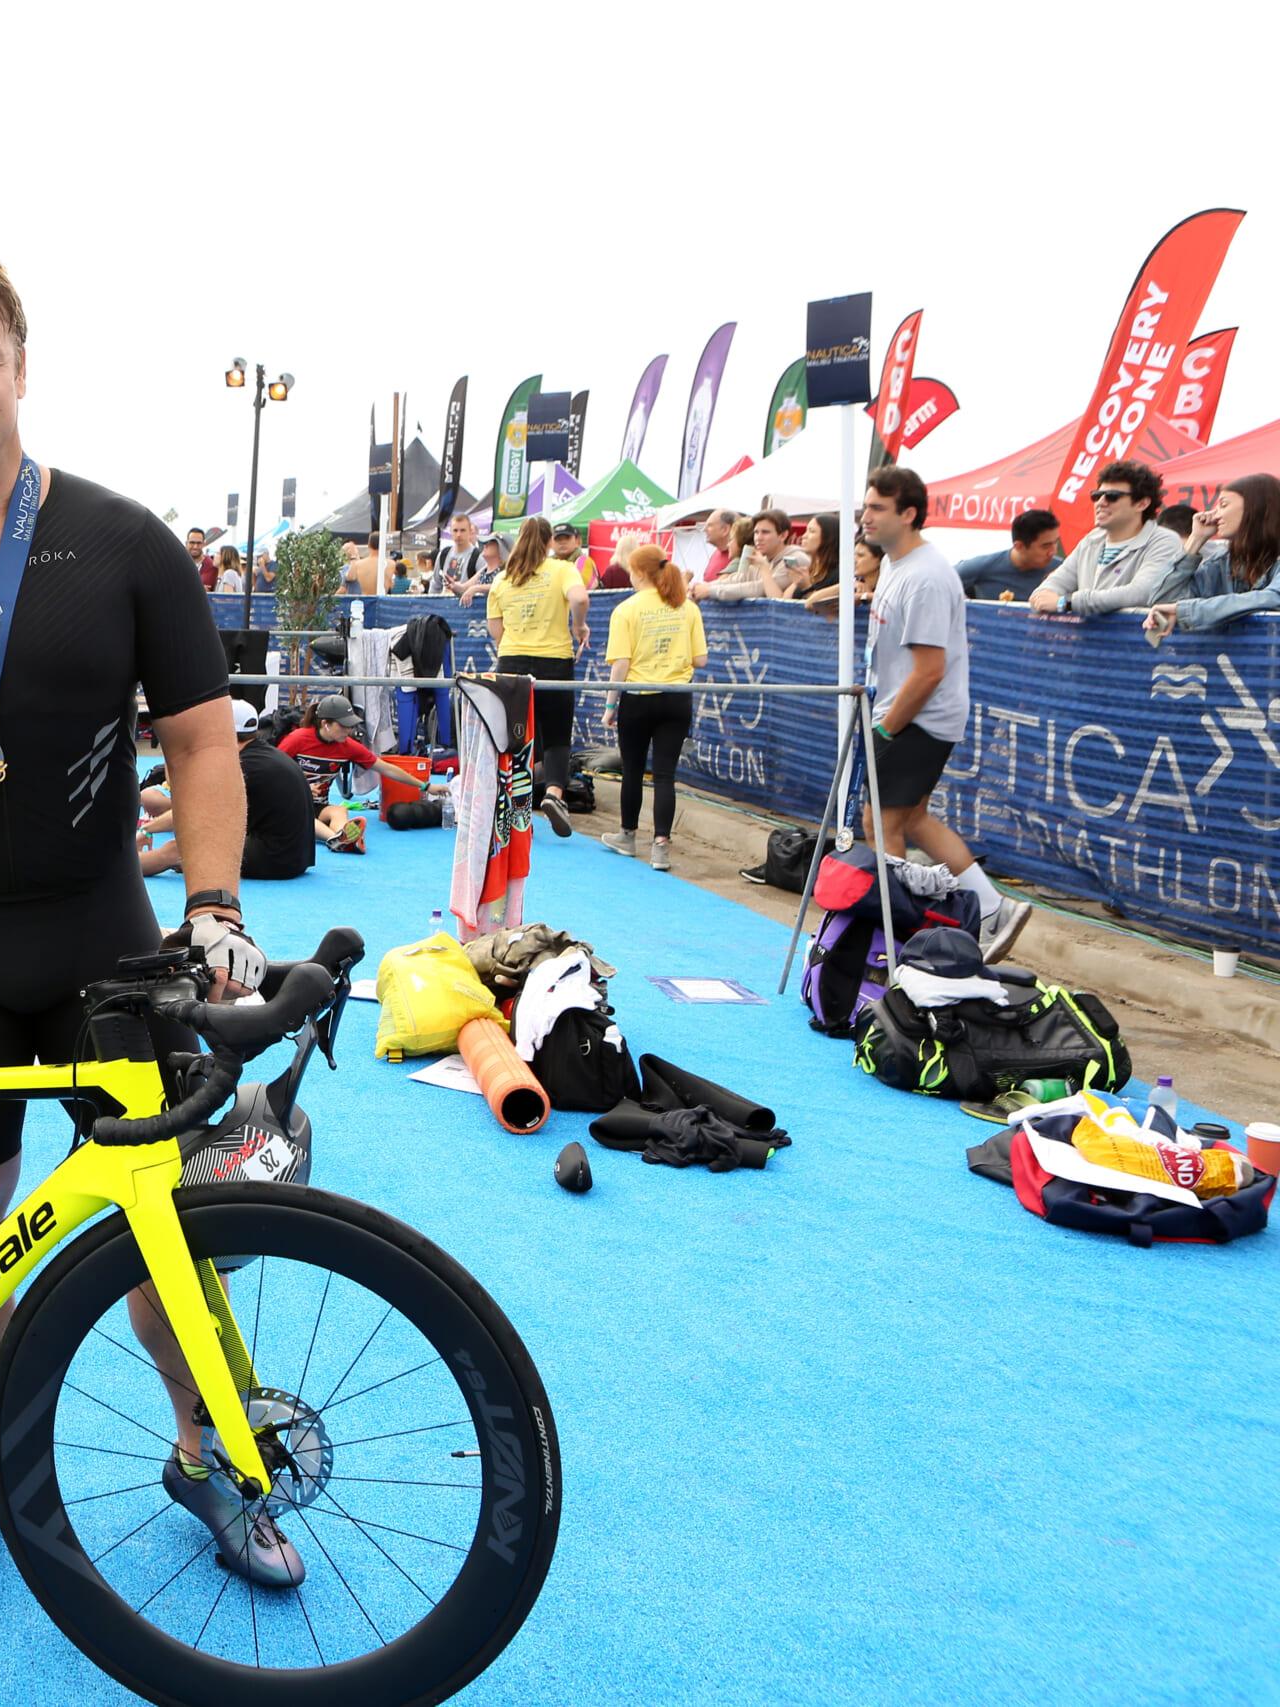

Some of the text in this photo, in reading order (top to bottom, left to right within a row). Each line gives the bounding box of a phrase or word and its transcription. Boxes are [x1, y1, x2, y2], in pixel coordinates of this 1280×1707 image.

[807, 343, 860, 359] NAUTICA
[1058, 281, 1169, 503] RECOVERY
[1105, 344, 1175, 460] ZONE
[903, 397, 938, 437] arm
[508, 451, 522, 494] ENERGY
[13, 479, 34, 540] NAUTICA
[23, 508, 39, 542] MALIBU
[949, 493, 1036, 523] POINTS
[942, 702, 1200, 834] UTICA
[259, 1148, 280, 1173] 28
[532, 1406, 554, 1515] CONTINENTAL
